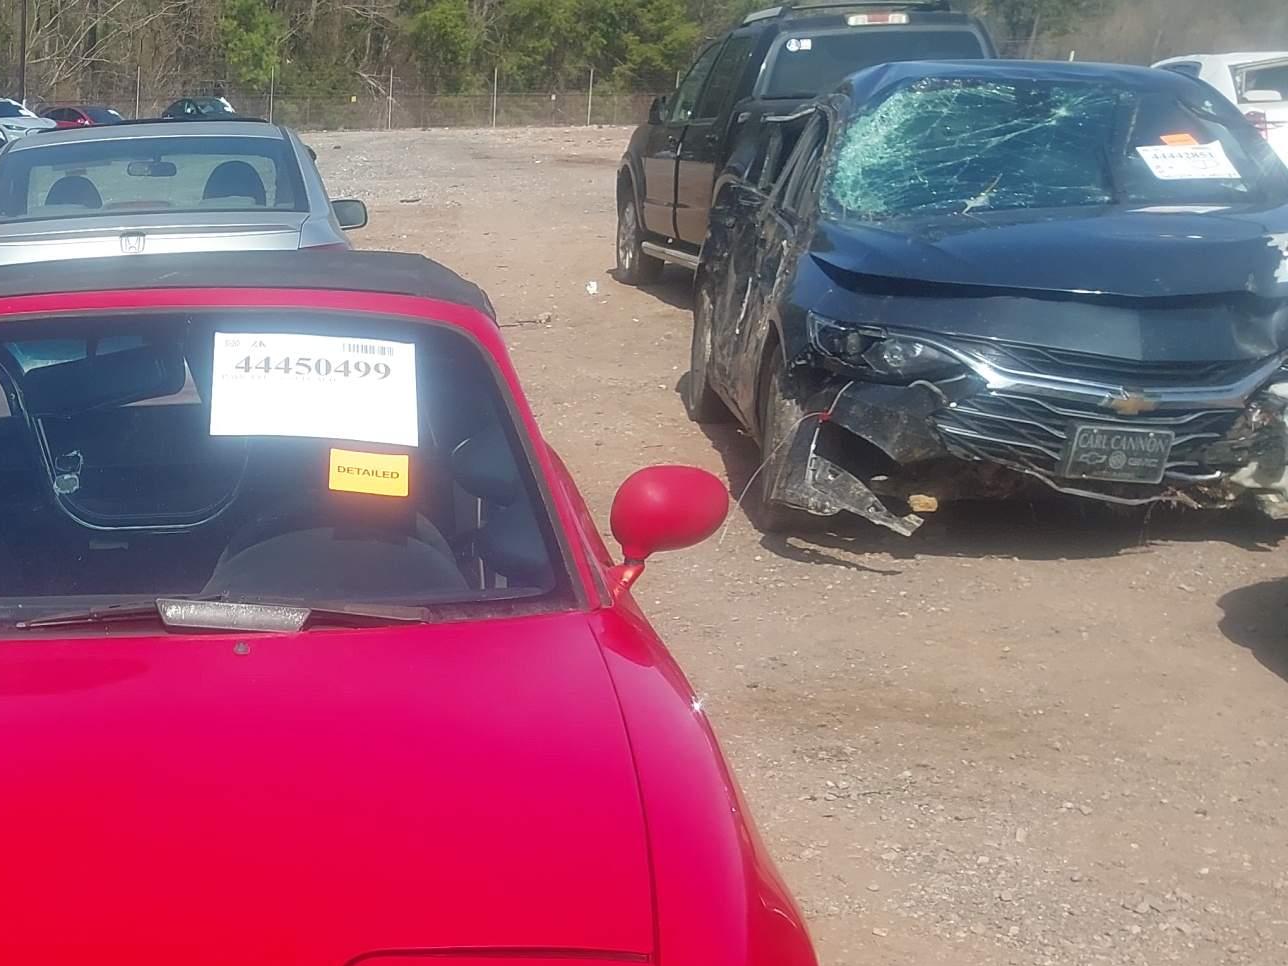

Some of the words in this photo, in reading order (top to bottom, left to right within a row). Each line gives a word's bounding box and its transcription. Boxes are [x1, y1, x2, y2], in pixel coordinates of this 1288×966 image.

[234, 355, 392, 380] 44450499
[1079, 433, 1108, 448] CARL
[1112, 435, 1168, 452] CANNON
[337, 465, 400, 479] DETAILED
